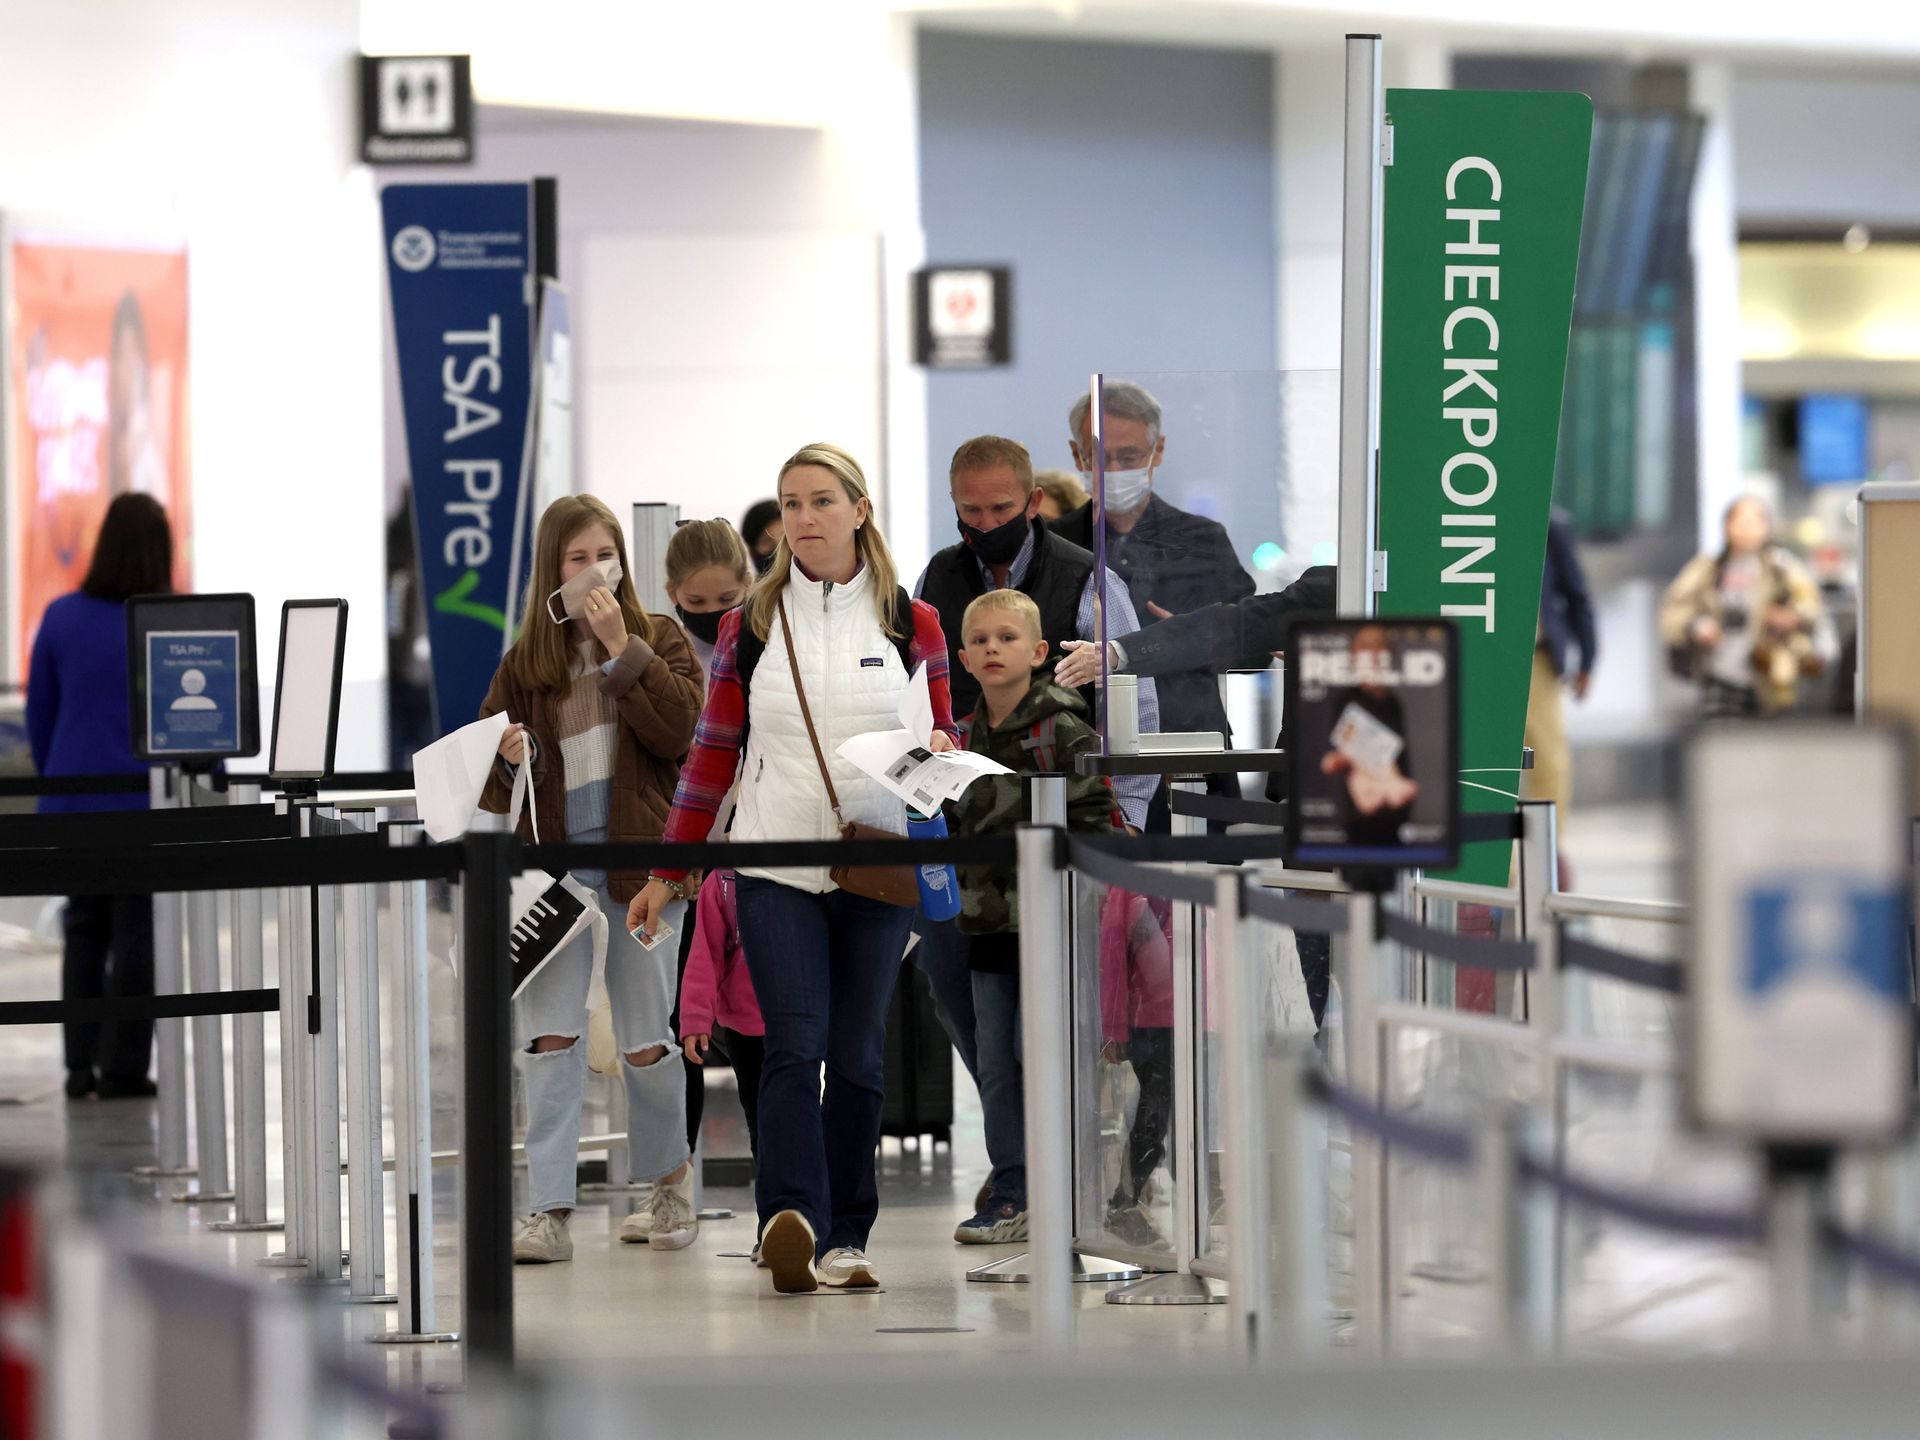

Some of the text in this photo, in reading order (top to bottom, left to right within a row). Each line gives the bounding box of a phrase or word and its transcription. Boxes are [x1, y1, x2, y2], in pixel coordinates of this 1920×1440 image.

[442, 314, 502, 443] TSA
[1440, 156, 1502, 633] CHECKPOINT
[443, 459, 502, 566] Pre
